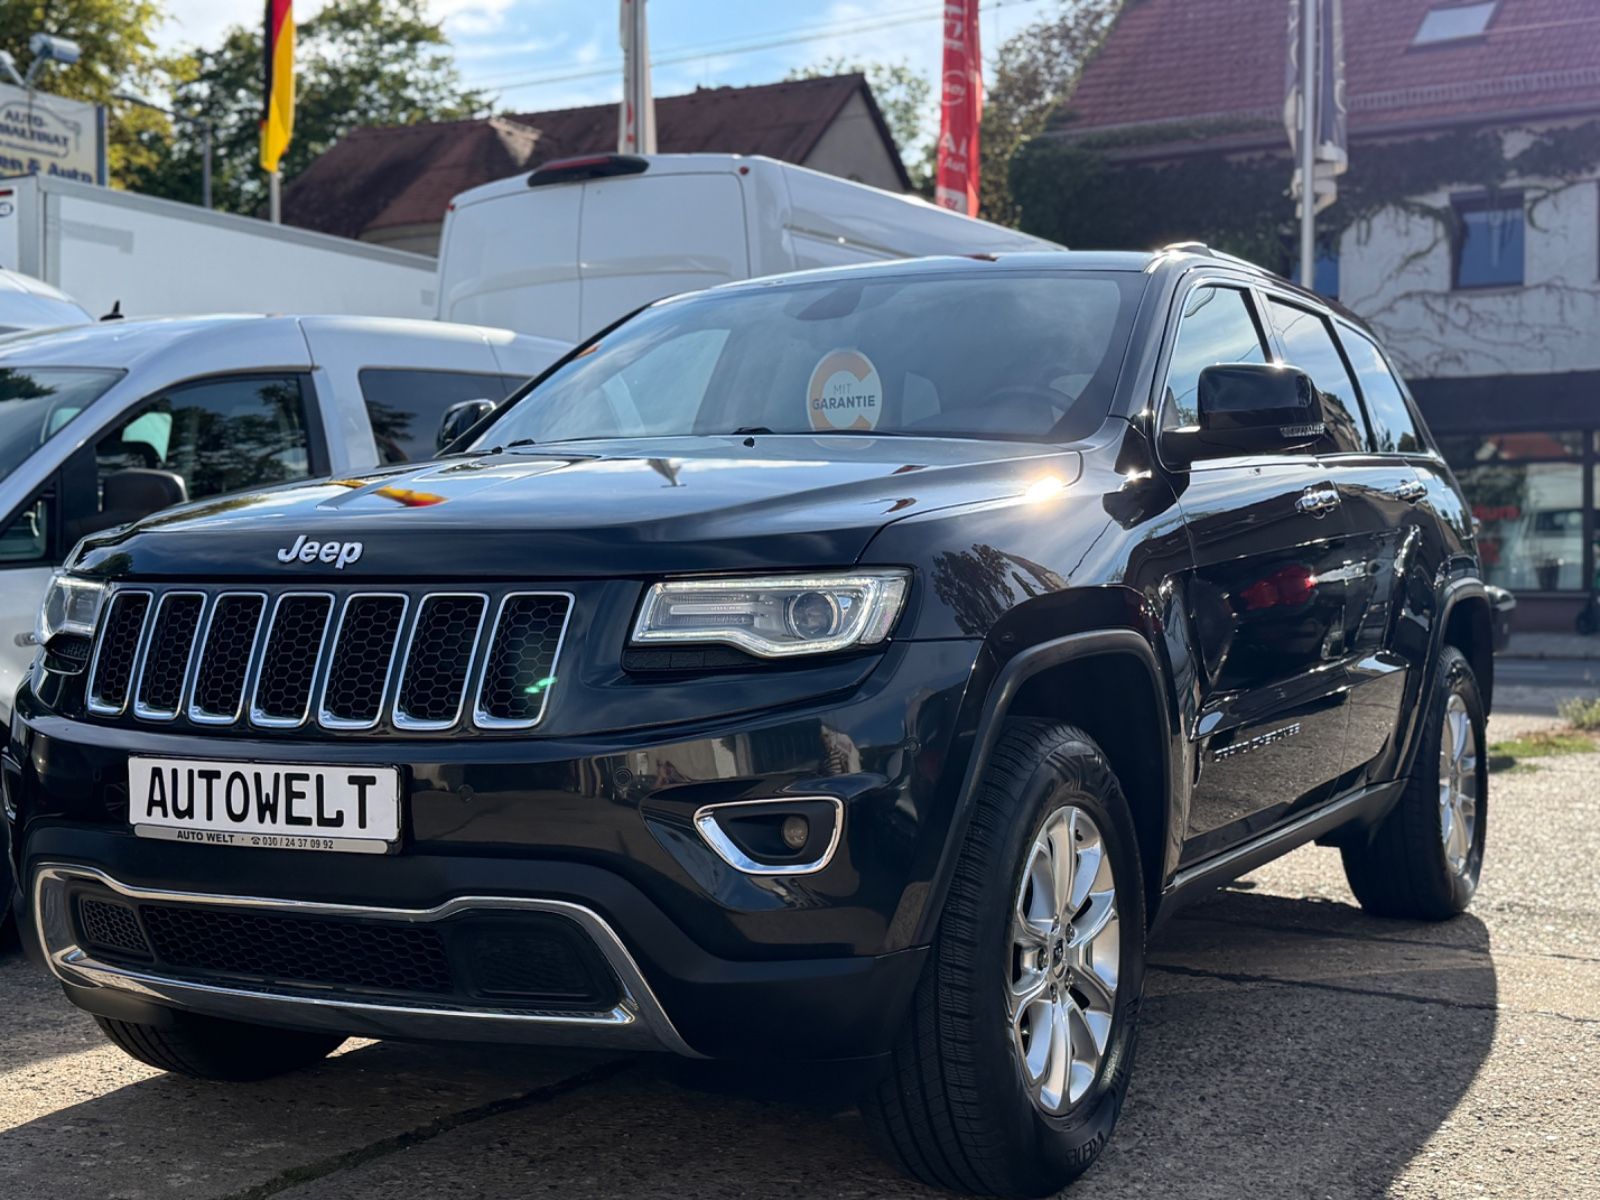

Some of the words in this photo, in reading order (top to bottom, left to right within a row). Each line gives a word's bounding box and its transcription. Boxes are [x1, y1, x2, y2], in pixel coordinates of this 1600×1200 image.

[833, 383, 853, 396] MIT
[812, 395, 876, 410] GARANTIE
[277, 534, 363, 570] Jeep
[146, 766, 377, 829] AUTOWELT
[177, 830, 204, 841] AUTO
[206, 832, 235, 844] WELT
[262, 836, 278, 846] 030
[285, 838, 296, 847] 24
[298, 839, 308, 848] 37
[310, 839, 321, 849] 09
[323, 839, 334, 849] 92
